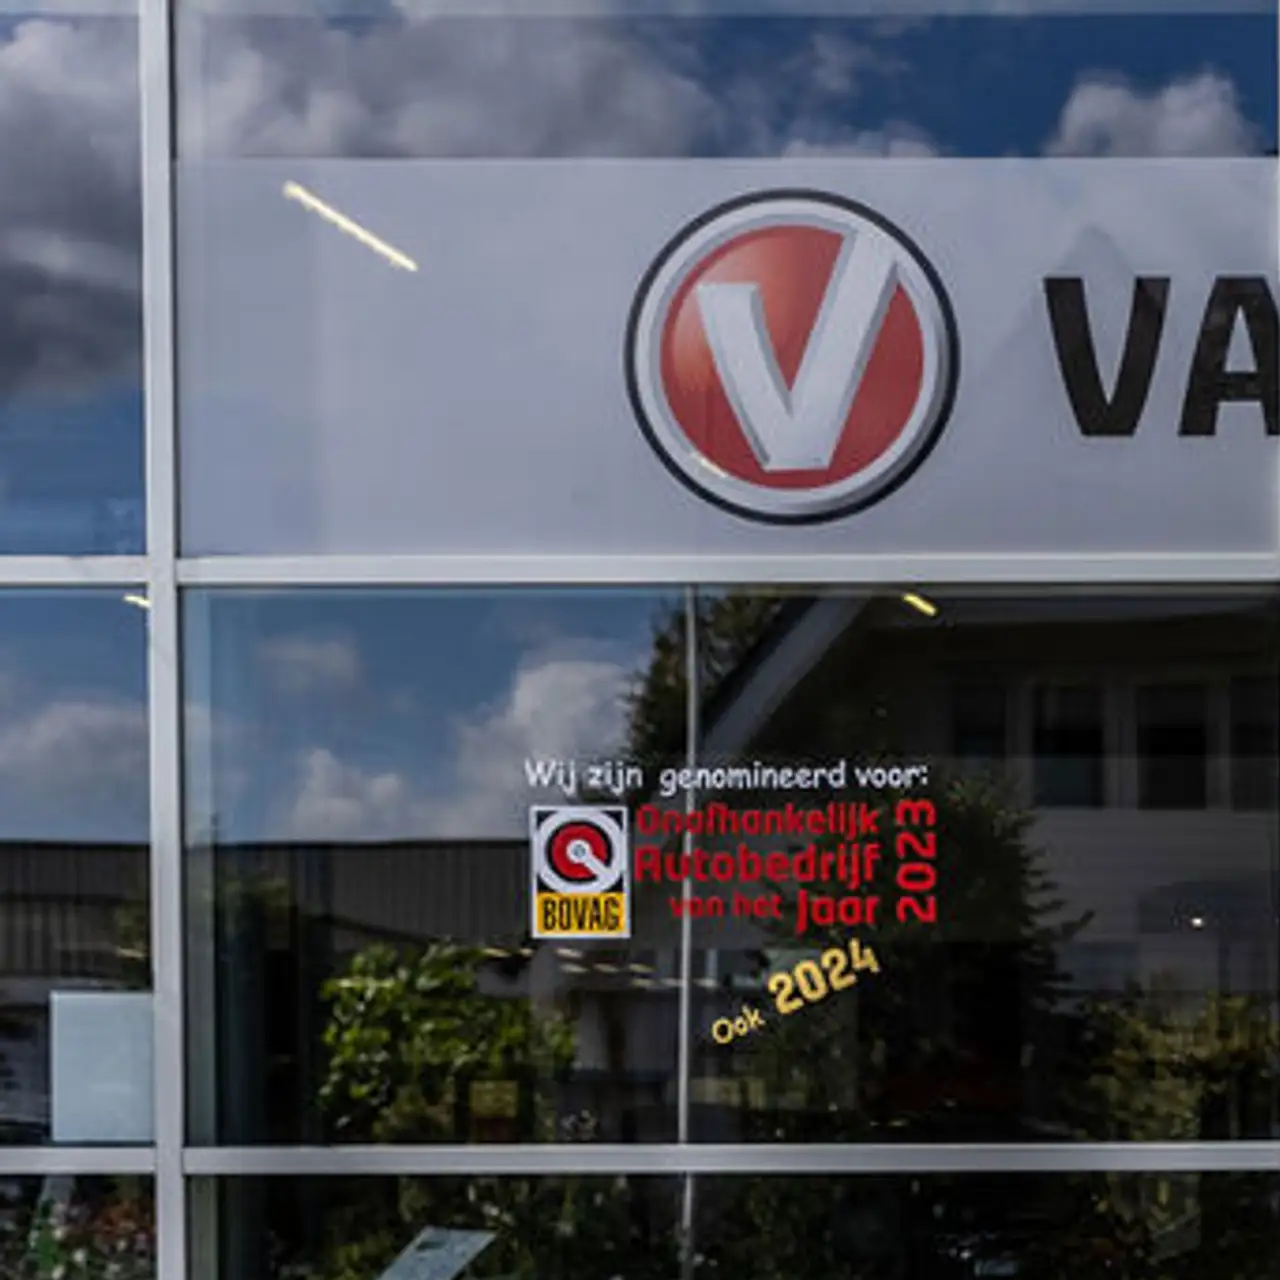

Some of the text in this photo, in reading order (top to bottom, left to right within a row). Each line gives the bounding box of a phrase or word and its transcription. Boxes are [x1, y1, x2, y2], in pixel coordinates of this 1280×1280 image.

[697, 226, 899, 472] V
[525, 758, 929, 797] Wij zijn genomineerd voor:
[635, 843, 882, 889] Autobedrijf
[896, 799, 938, 922] 2023
[542, 897, 620, 931] BOVAG
[668, 897, 725, 917] van
[732, 892, 784, 918] het
[711, 938, 881, 1044] Ook 2024
